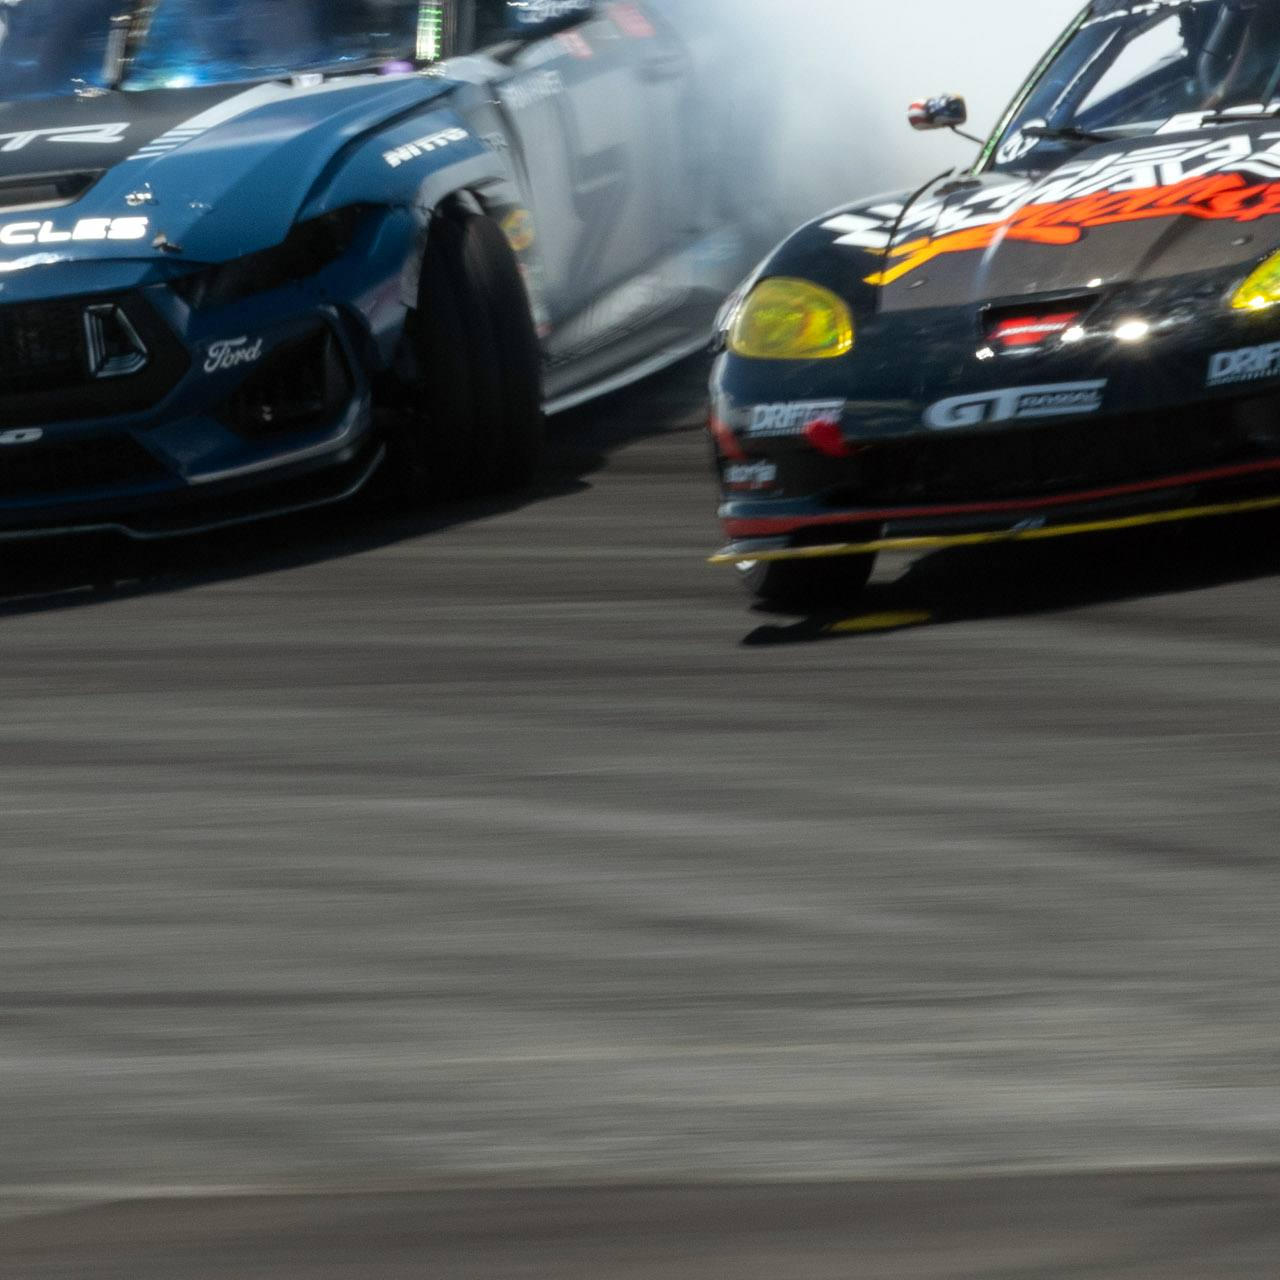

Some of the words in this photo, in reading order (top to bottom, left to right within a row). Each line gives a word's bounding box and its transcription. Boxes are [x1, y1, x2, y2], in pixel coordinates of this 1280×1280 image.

[381, 126, 470, 169] NITTO
[203, 334, 263, 373] Ford
[923, 382, 1030, 430] GT
